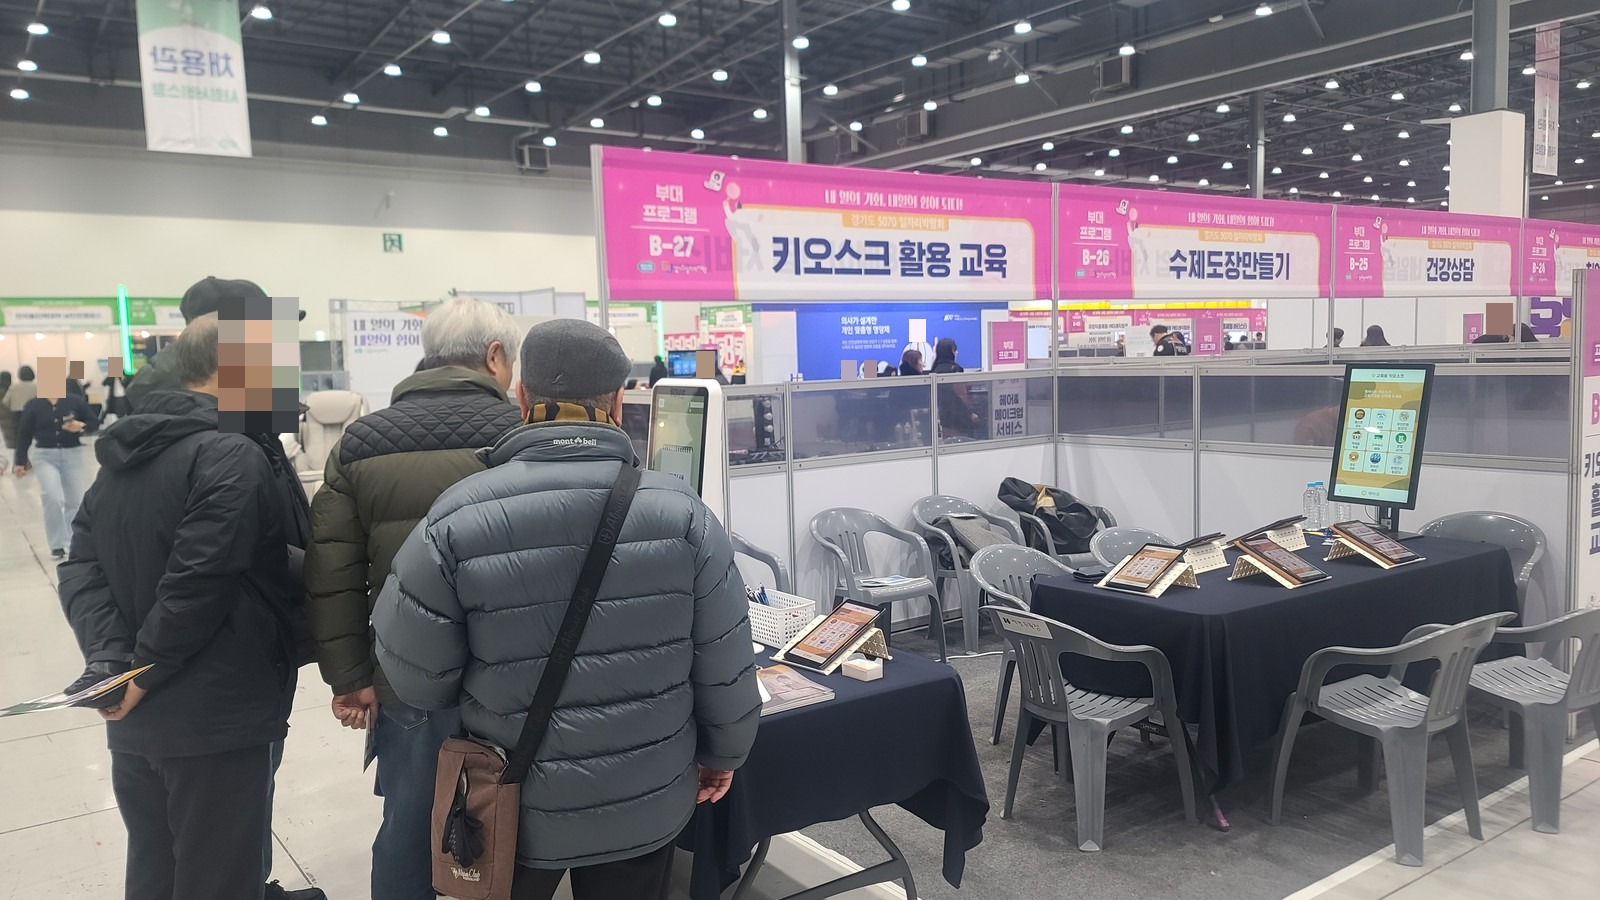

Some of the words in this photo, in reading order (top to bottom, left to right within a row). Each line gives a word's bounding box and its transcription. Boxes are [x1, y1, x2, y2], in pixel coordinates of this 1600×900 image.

[656, 184, 683, 203] 부대
[824, 189, 836, 204] 내
[920, 195, 938, 210] 힘이
[941, 197, 963, 211] 되다!
[643, 204, 698, 225] 프로그램
[850, 213, 875, 227] 경기도
[878, 215, 897, 227] 5070
[1087, 210, 1104, 224] 부대
[1079, 227, 1112, 241] 프로그램
[1354, 226, 1365, 237] 부대
[649, 234, 695, 258] B-27
[1348, 238, 1371, 251] 프로그램
[771, 236, 891, 276] 키오스크
[899, 240, 950, 278] 활용
[959, 242, 1008, 279] 교육
[1082, 249, 1109, 266] B-26
[1349, 257, 1369, 271] B-25
[1169, 249, 1290, 281] 수제도장만들기
[1426, 257, 1475, 282] 건강상담
[353, 319, 366, 331] 내
[841, 316, 860, 325] 의사가
[860, 315, 878, 325] 설계한
[841, 326, 853, 335] 개인
[873, 325, 890, 335] 영양제
[999, 393, 1019, 406] 헤어&
[994, 407, 1024, 420] 메이크업
[996, 421, 1023, 436] 서비스
